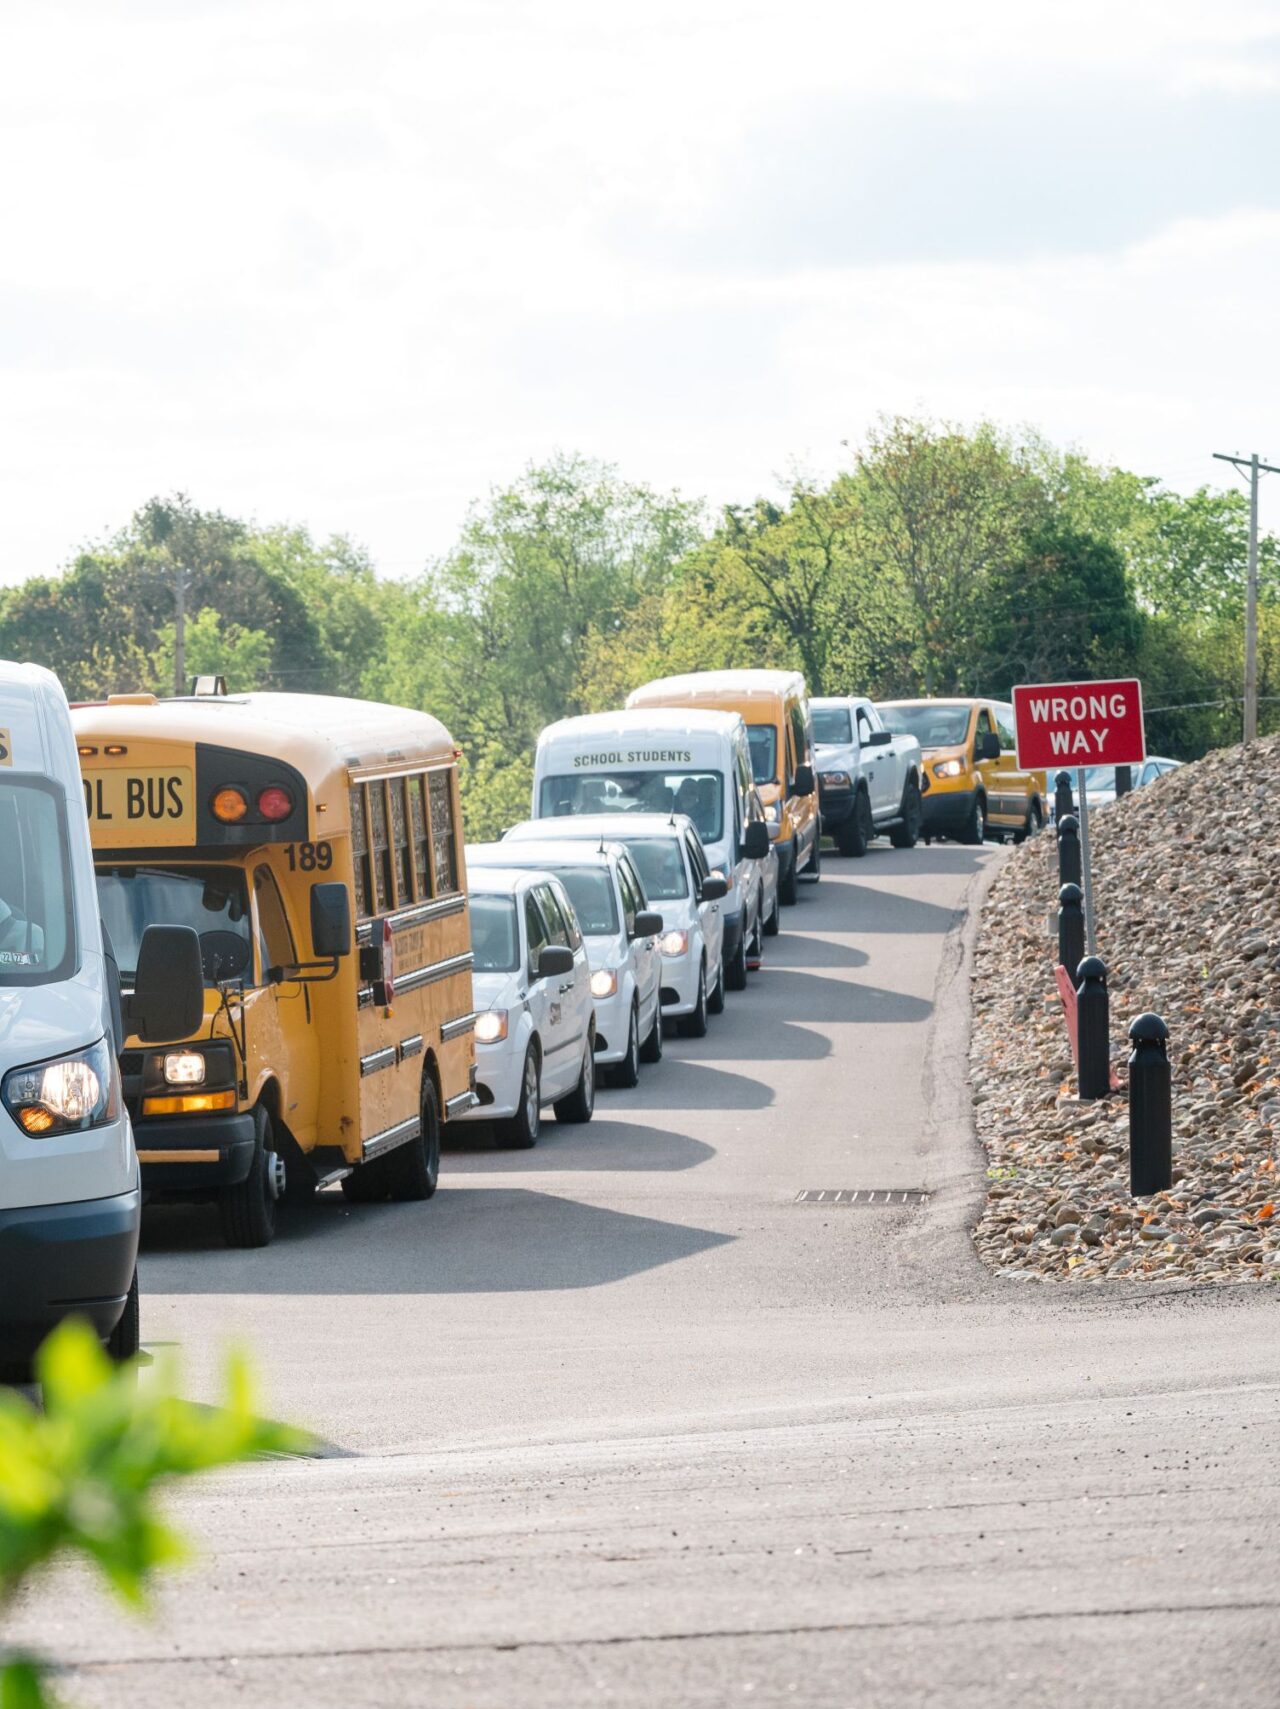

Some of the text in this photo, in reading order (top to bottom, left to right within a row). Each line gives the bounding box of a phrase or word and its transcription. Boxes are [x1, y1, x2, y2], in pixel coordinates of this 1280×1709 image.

[1029, 694, 1126, 723] WRONG
[1049, 728, 1110, 755] WAY
[574, 750, 691, 768] SCHOOL STUDENTS
[127, 776, 183, 819] BUS
[284, 842, 333, 871] 189
